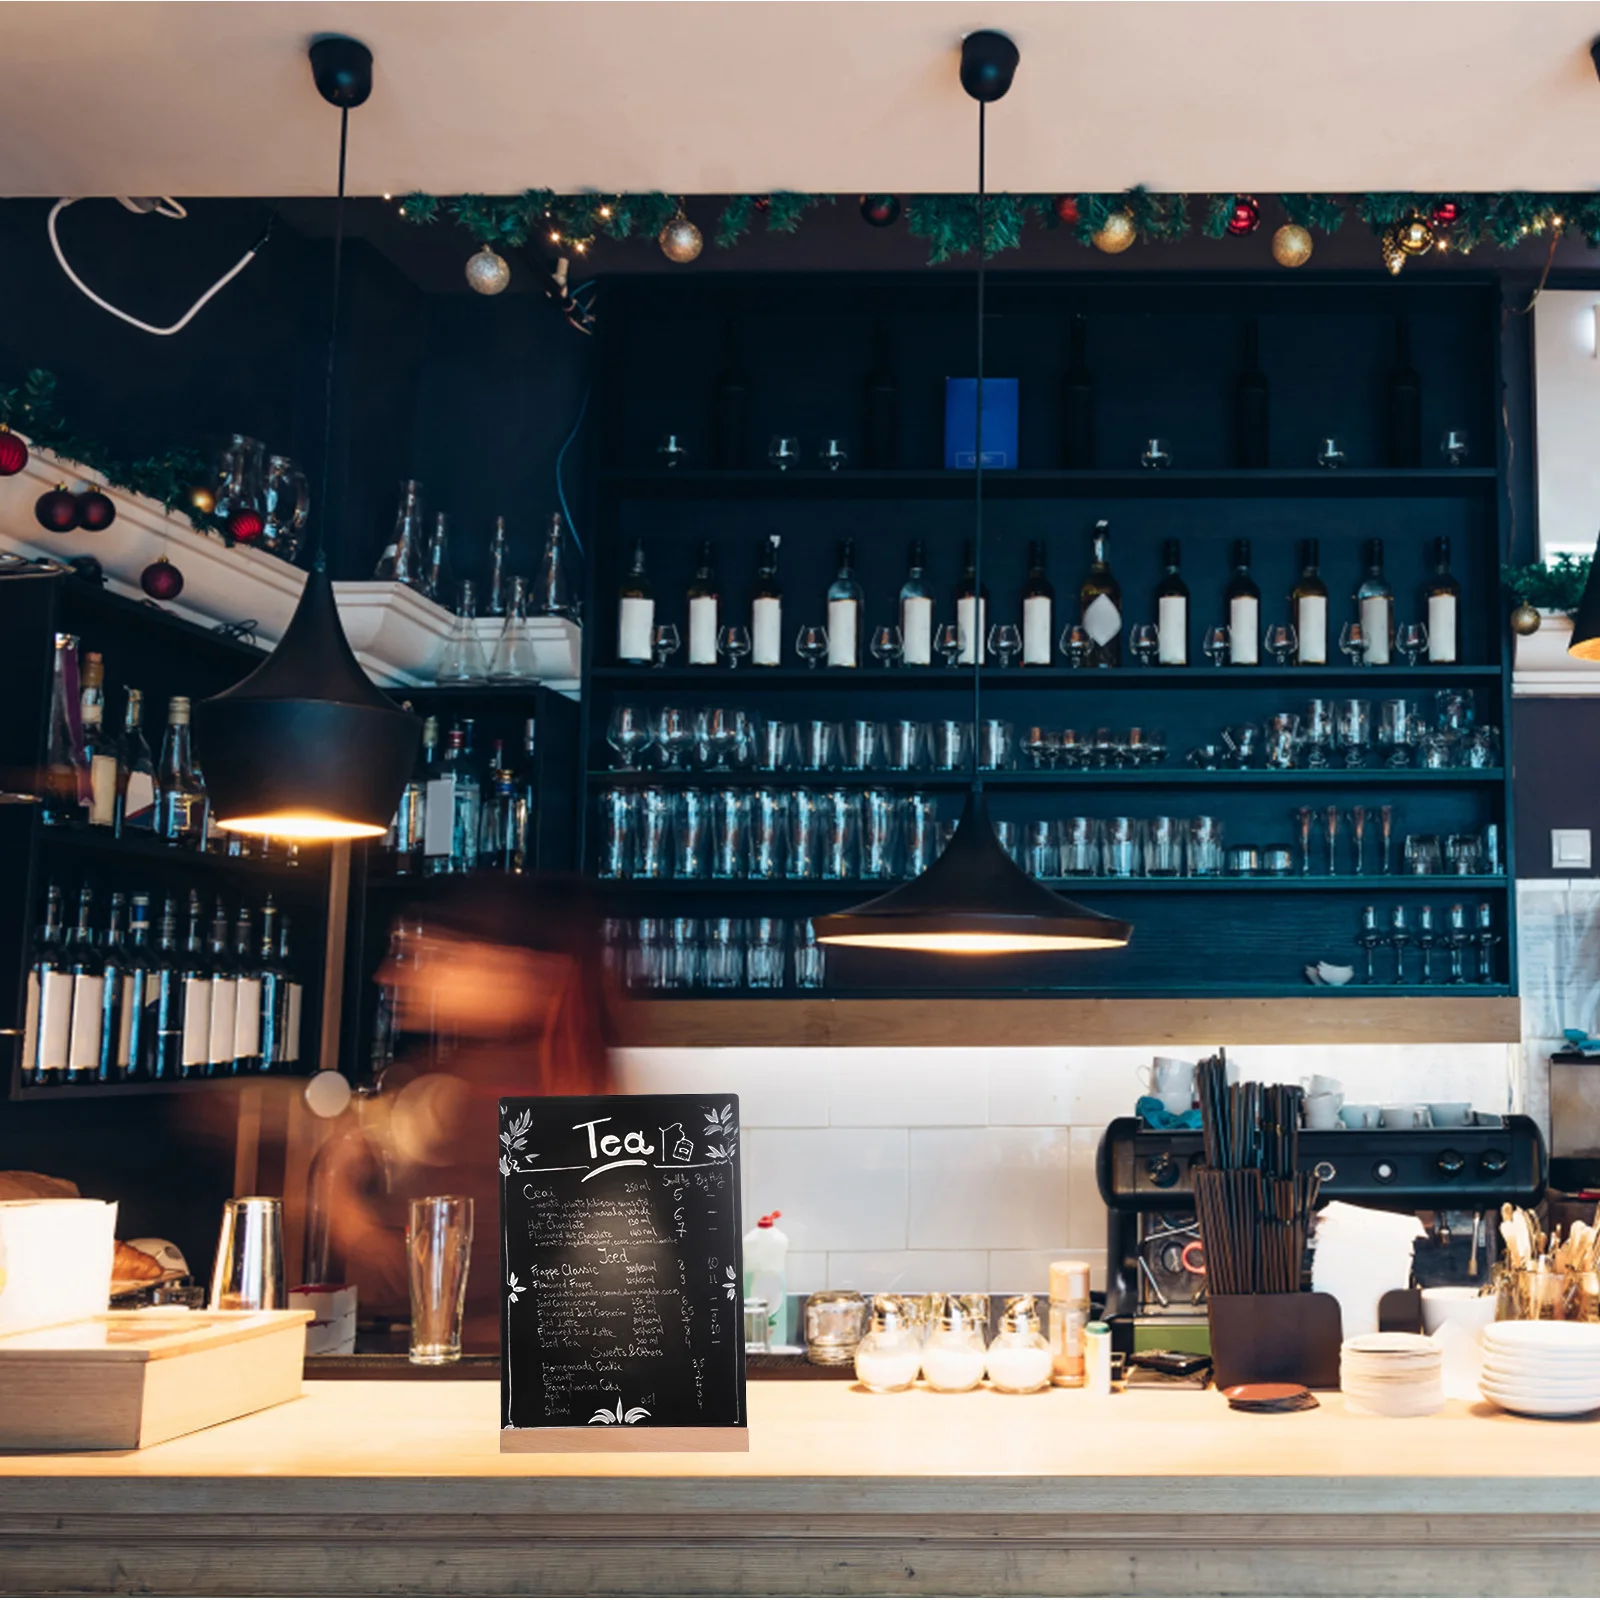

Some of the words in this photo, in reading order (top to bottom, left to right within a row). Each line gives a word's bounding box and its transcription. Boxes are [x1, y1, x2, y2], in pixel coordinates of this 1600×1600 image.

[572, 1117, 655, 1159] Tea
[523, 1183, 555, 1200] Ceai
[673, 1187, 684, 1201] 5
[673, 1206, 685, 1221] 6
[527, 1219, 544, 1230] Hot
[546, 1219, 585, 1231] Chocolate
[675, 1221, 688, 1238] 7
[578, 1230, 614, 1240] Chocolate
[597, 1247, 631, 1265] Iced
[707, 1256, 719, 1270] 10
[530, 1263, 560, 1280] Frappe
[561, 1262, 600, 1277] Classic
[569, 1277, 594, 1290] Frappe
[680, 1295, 688, 1306] 6
[592, 1326, 617, 1338] Latte
[684, 1325, 691, 1336] 8
[710, 1324, 721, 1335] 10
[539, 1337, 558, 1348] Iced
[562, 1336, 582, 1348] Tea
[684, 1336, 691, 1349] 4
[590, 1346, 628, 1359] Sweets
[541, 1360, 595, 1373] Homemade
[596, 1360, 624, 1372] Cookie
